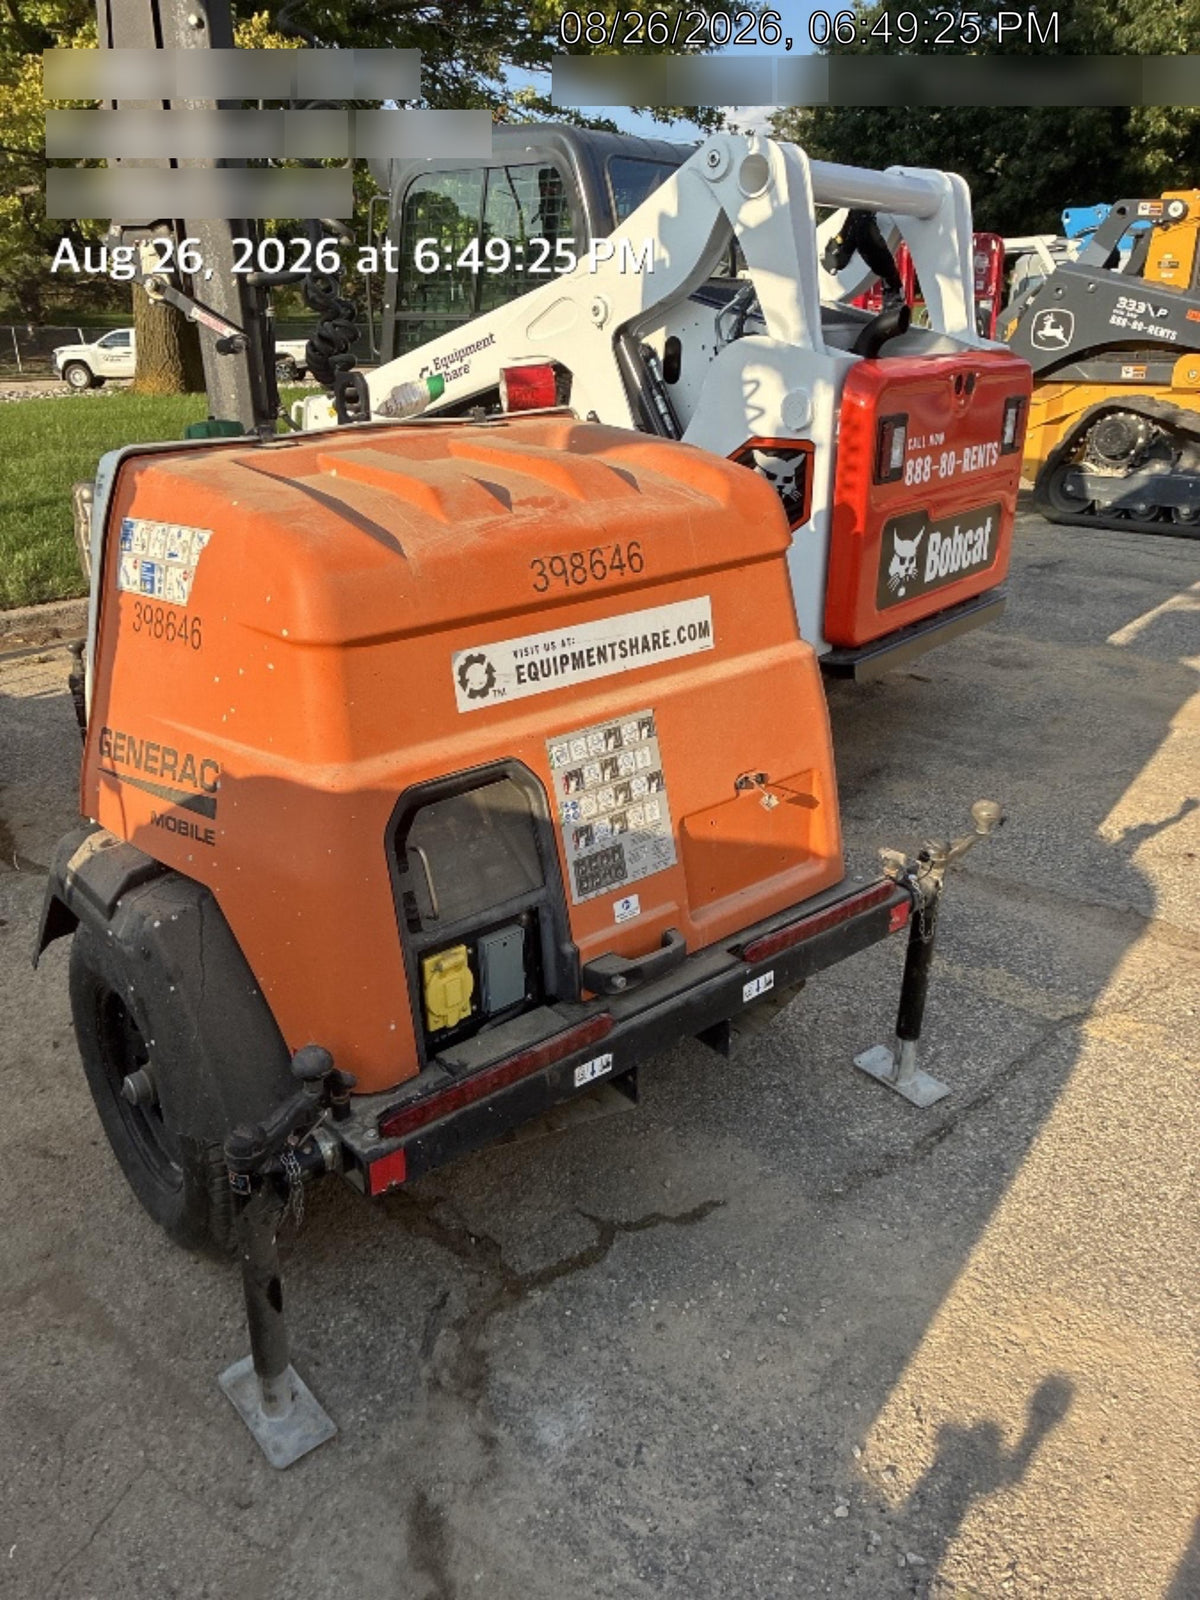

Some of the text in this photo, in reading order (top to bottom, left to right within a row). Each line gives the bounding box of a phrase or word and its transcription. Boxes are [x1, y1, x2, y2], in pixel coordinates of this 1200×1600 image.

[432, 333, 496, 370] Equipment
[443, 364, 470, 382] hare
[904, 441, 999, 486] 888-80-RENTS
[530, 541, 645, 592] 398646
[924, 517, 993, 583] Bobcat
[133, 601, 202, 650] 398646
[513, 637, 576, 659] VISIT US AT:
[515, 620, 711, 685] EQUIPMENTSHARE.COM
[99, 727, 220, 793] GENERAC
[150, 811, 216, 847] MOBILE
